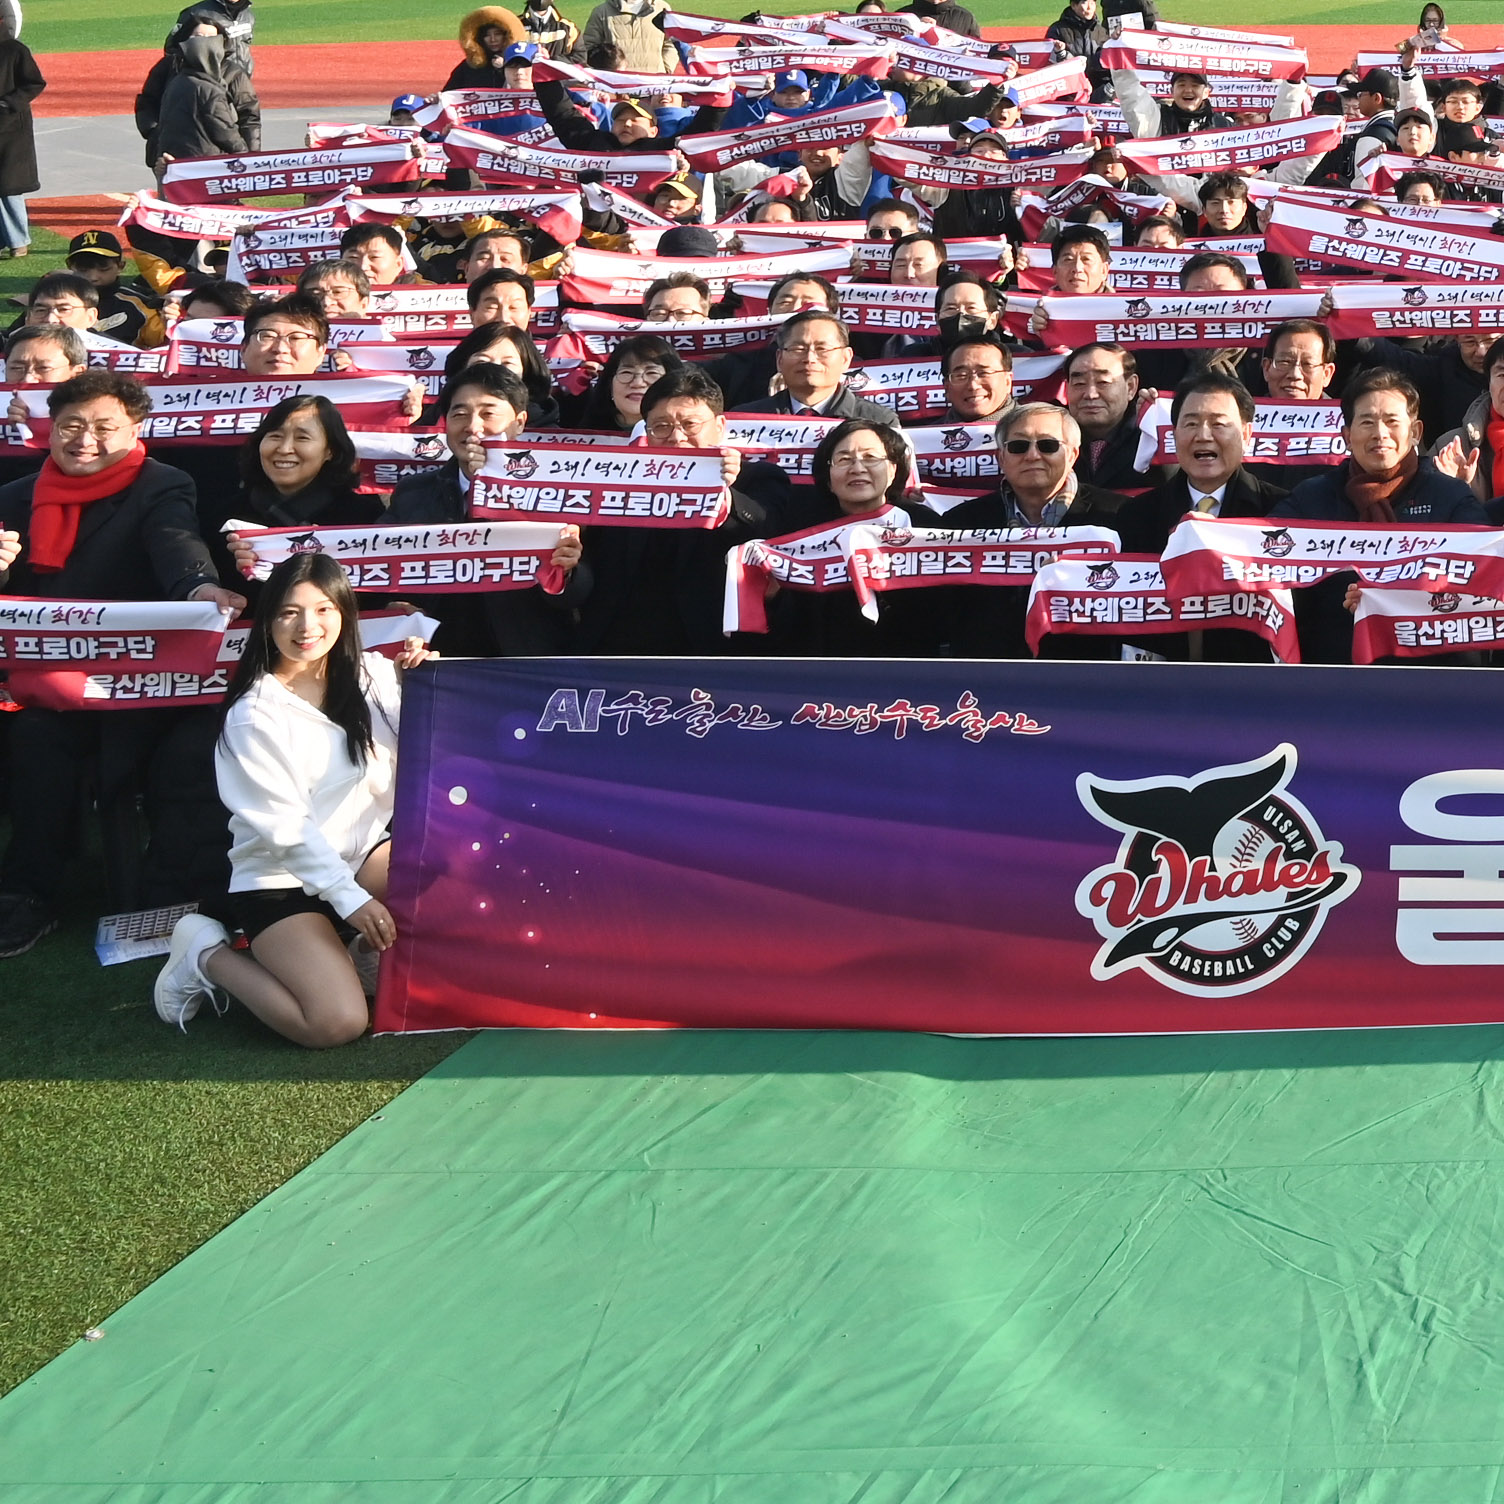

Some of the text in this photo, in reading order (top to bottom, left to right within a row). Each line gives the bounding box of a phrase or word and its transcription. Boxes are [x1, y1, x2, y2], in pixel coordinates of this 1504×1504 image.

[1136, 50, 1272, 76] 울산웨일즈 프로야구단
[716, 121, 866, 166] 울산웨일즈 프로야구단
[1157, 138, 1306, 171] 울산웨일즈 프로야구단
[205, 165, 374, 197] 울산웨일즈 프로야구단
[904, 164, 1057, 185] 울산웨일즈 프로야구단
[1308, 234, 1499, 281] 울산웨일즈 프로야구단
[1094, 321, 1198, 343] 울산웨일즈
[1371, 309, 1472, 330] 울산웨일즈
[163, 384, 301, 409] 그래! 역시! 최강!
[549, 457, 696, 479] 그래! 역시! 최강!
[337, 528, 491, 554] 그래! 역시! 최강!
[397, 554, 540, 586] 프로야구단
[51, 605, 106, 626] 최강!
[1049, 595, 1171, 624] 울산웨일즈
[15, 636, 156, 661] 프로야구단
[1262, 804, 1307, 853] ULSAN
[1090, 840, 1331, 928] Whales
[1169, 916, 1300, 976] BASEBALL CLUB
